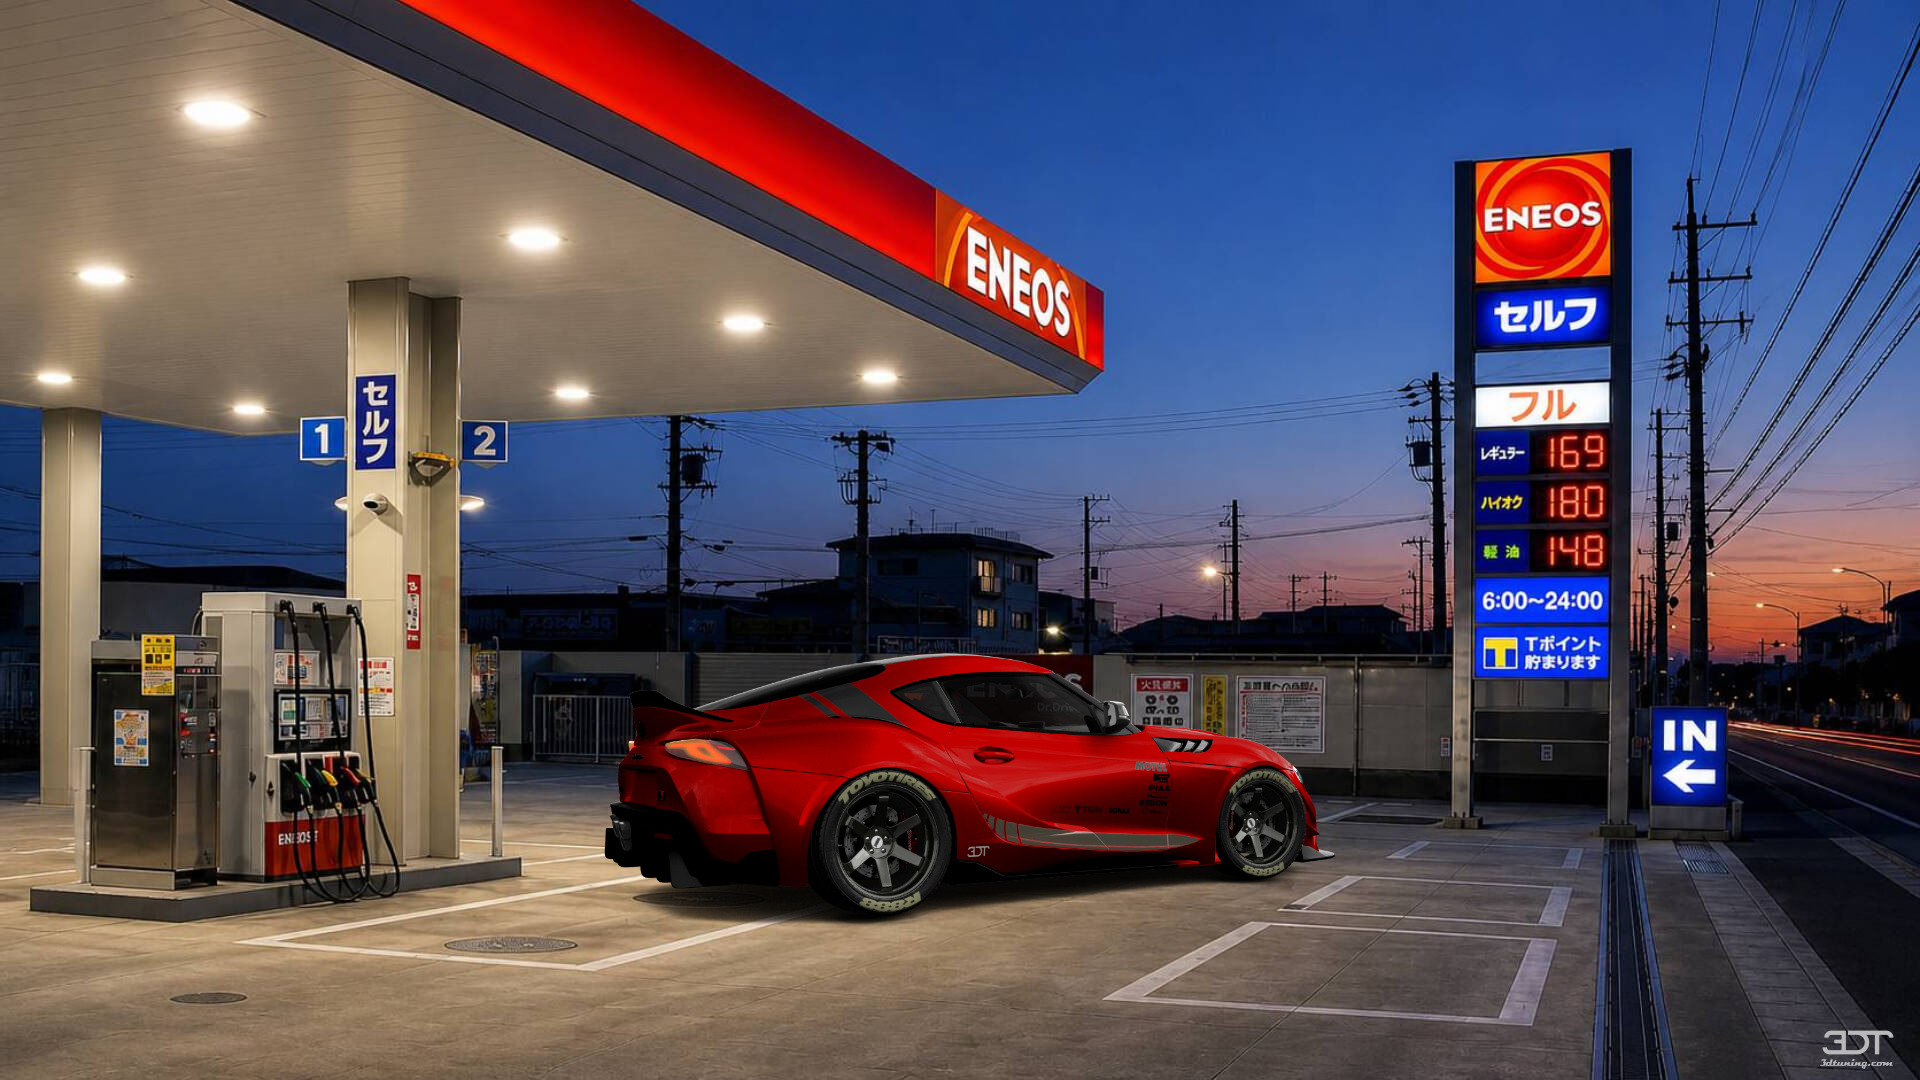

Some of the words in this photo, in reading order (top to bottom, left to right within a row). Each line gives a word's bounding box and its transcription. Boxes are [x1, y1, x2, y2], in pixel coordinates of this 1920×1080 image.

[1484, 200, 1602, 233] ENEOS
[967, 226, 1071, 337] ENEOS
[1493, 297, 1598, 333] セルフ
[1508, 388, 1578, 423] フル
[362, 380, 390, 465] セルフ
[314, 423, 329, 454] 1
[473, 425, 497, 456] 2
[1481, 446, 1526, 461] レギュラー
[1549, 435, 1604, 468] 169
[1481, 495, 1523, 510] ハイオク
[1549, 485, 1604, 519] 180
[1549, 534, 1604, 567] 148
[1524, 635, 1602, 652] Tポイント
[1524, 654, 1601, 670] 貯まります
[1663, 719, 1717, 751] IN
[1135, 761, 1168, 772] MOTUL
[1148, 784, 1170, 792] PIAA
[966, 845, 991, 858] 3DT
